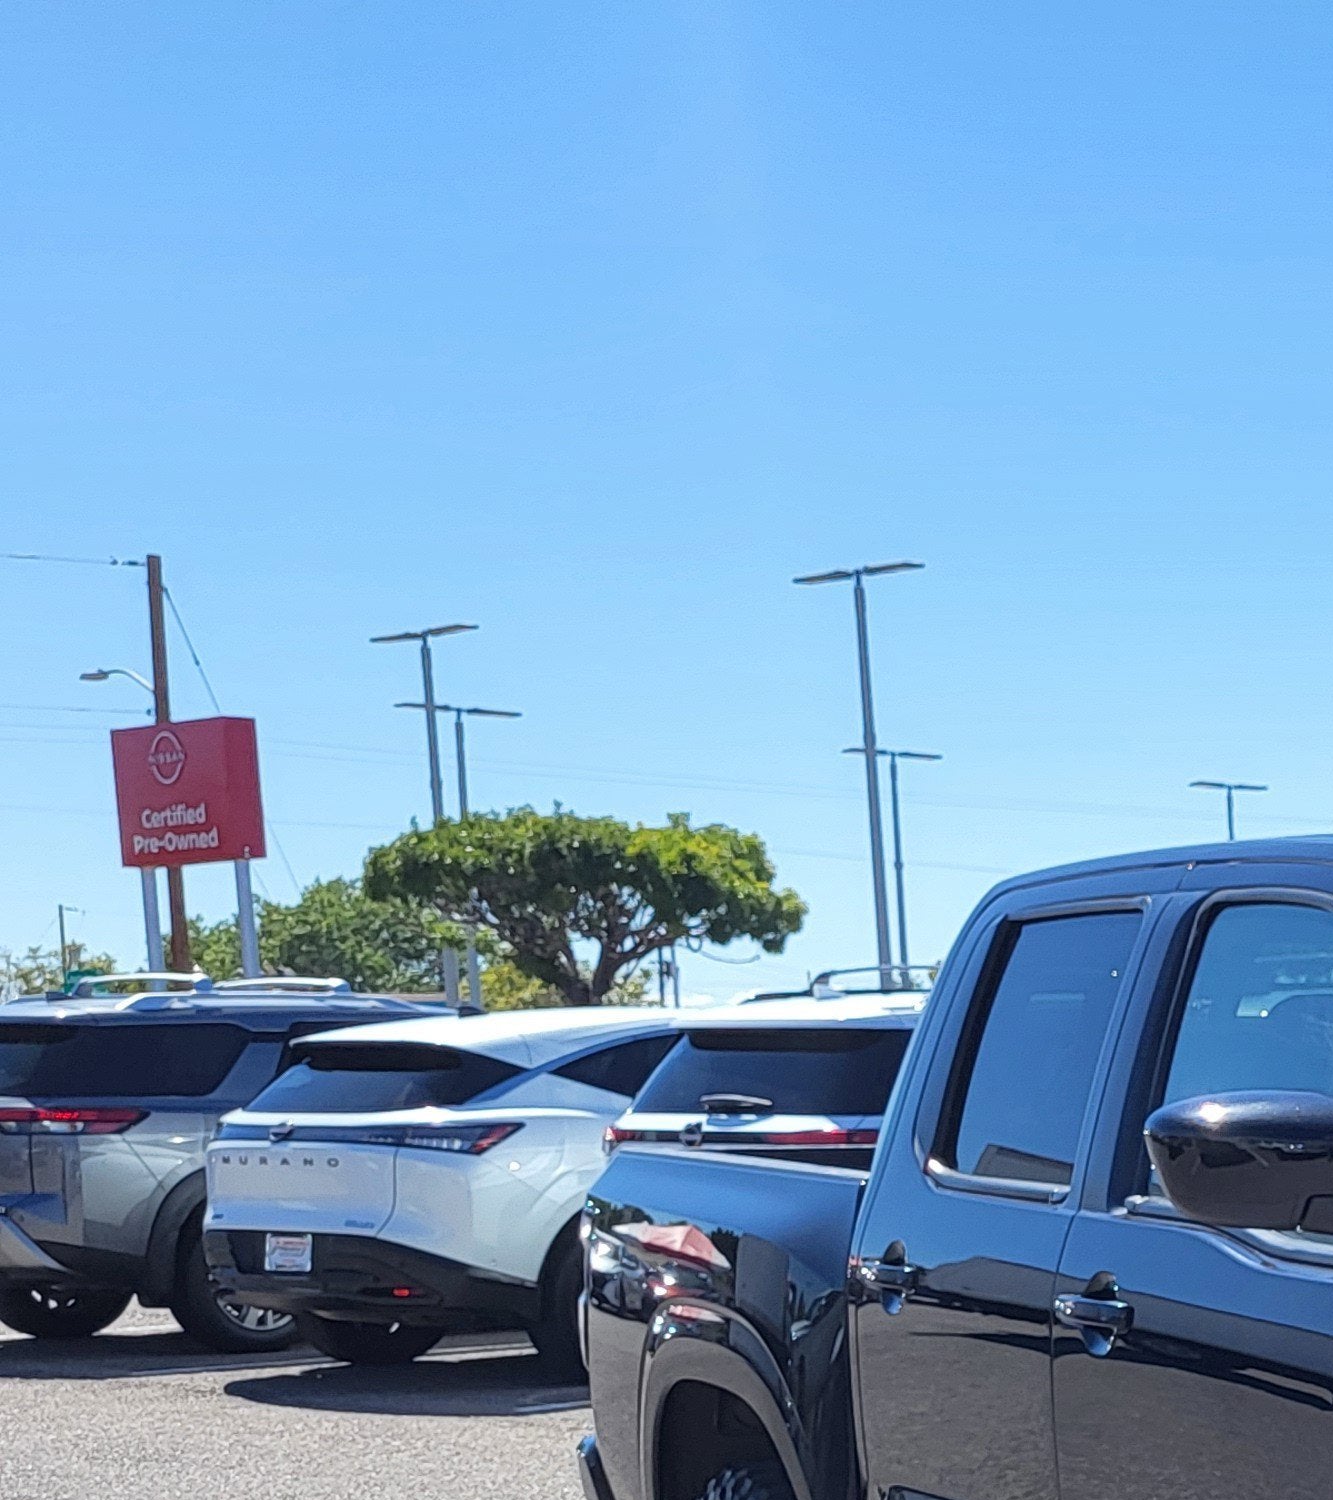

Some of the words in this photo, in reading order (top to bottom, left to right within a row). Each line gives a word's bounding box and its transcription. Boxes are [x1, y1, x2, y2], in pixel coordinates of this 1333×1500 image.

[141, 803, 206, 829] Certified
[133, 826, 219, 855] Pre-Owned
[222, 1155, 340, 1168] MURANO
